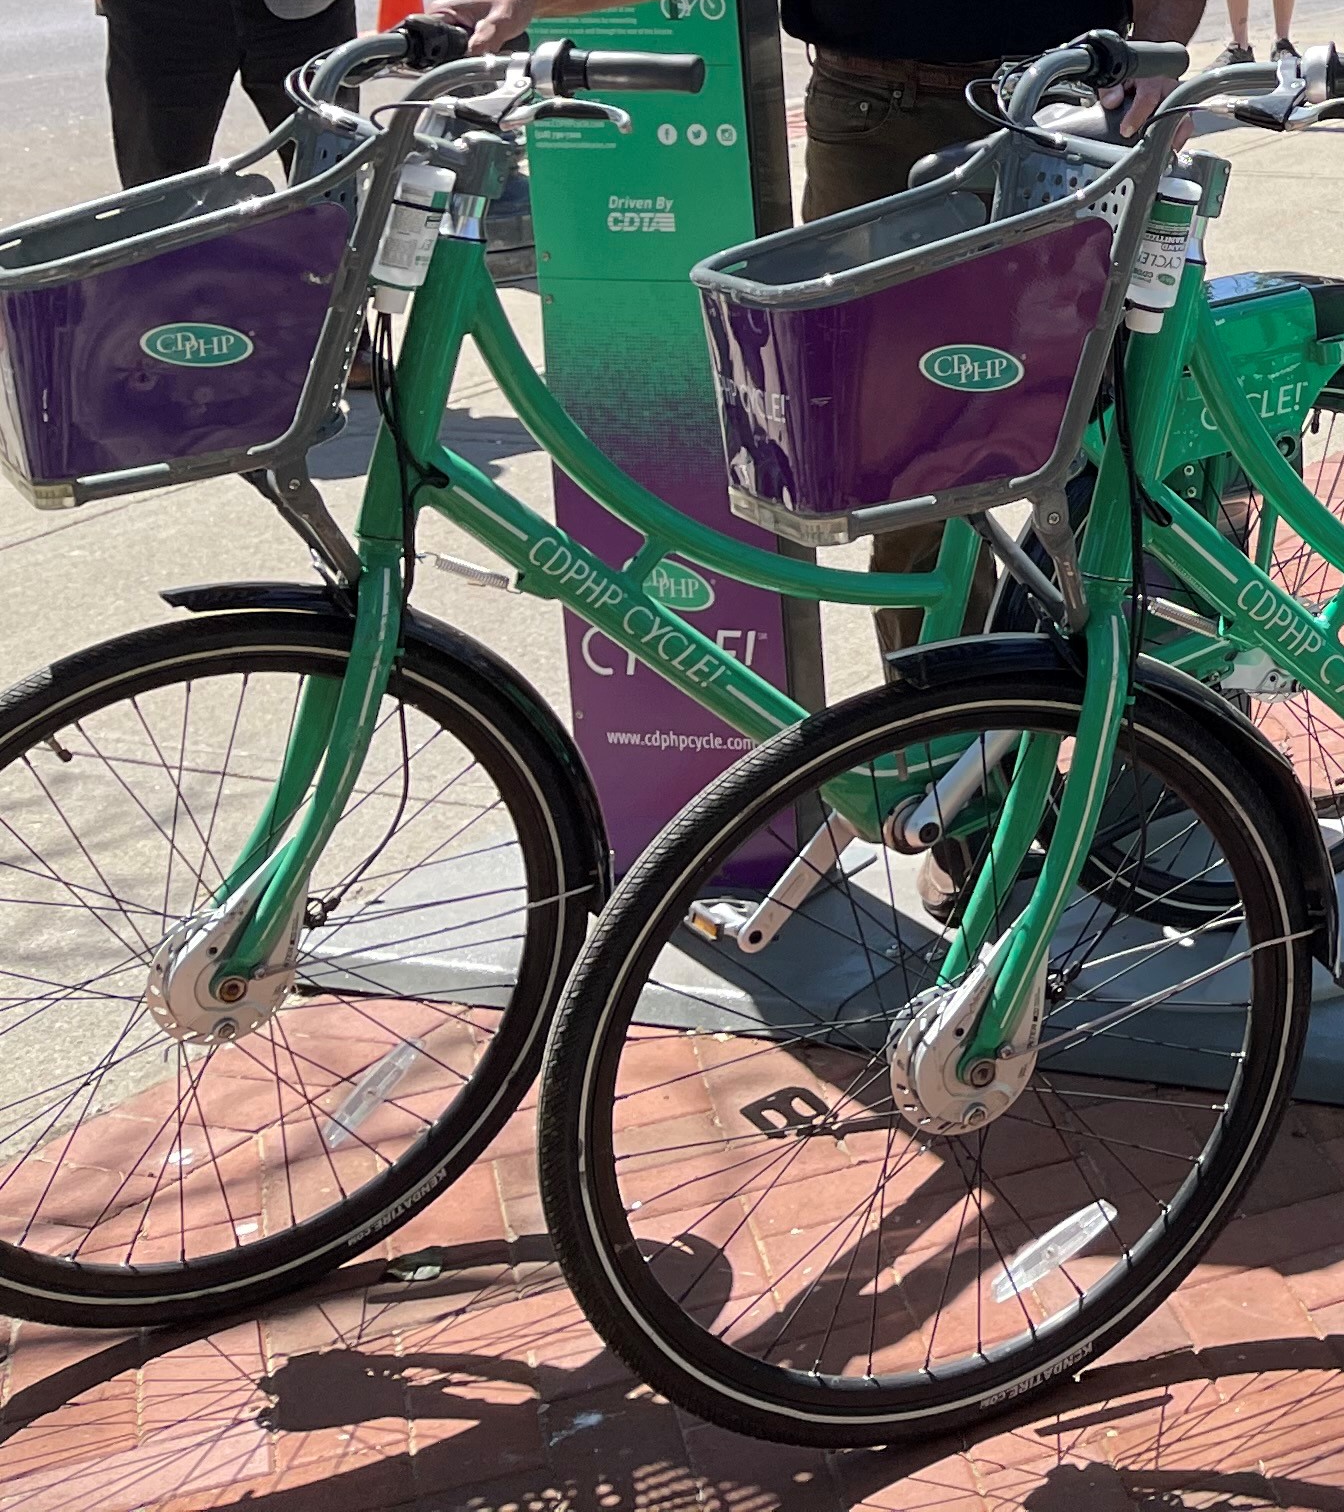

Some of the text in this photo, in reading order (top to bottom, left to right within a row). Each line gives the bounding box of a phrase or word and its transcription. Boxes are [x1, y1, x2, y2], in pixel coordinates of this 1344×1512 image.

[608, 195, 673, 212] Driven By
[156, 331, 236, 361] CDPHP
[932, 350, 1009, 384] CDPHP
[528, 536, 724, 688] CDPHP CYCLE!
[1235, 579, 1324, 658] CDPHP
